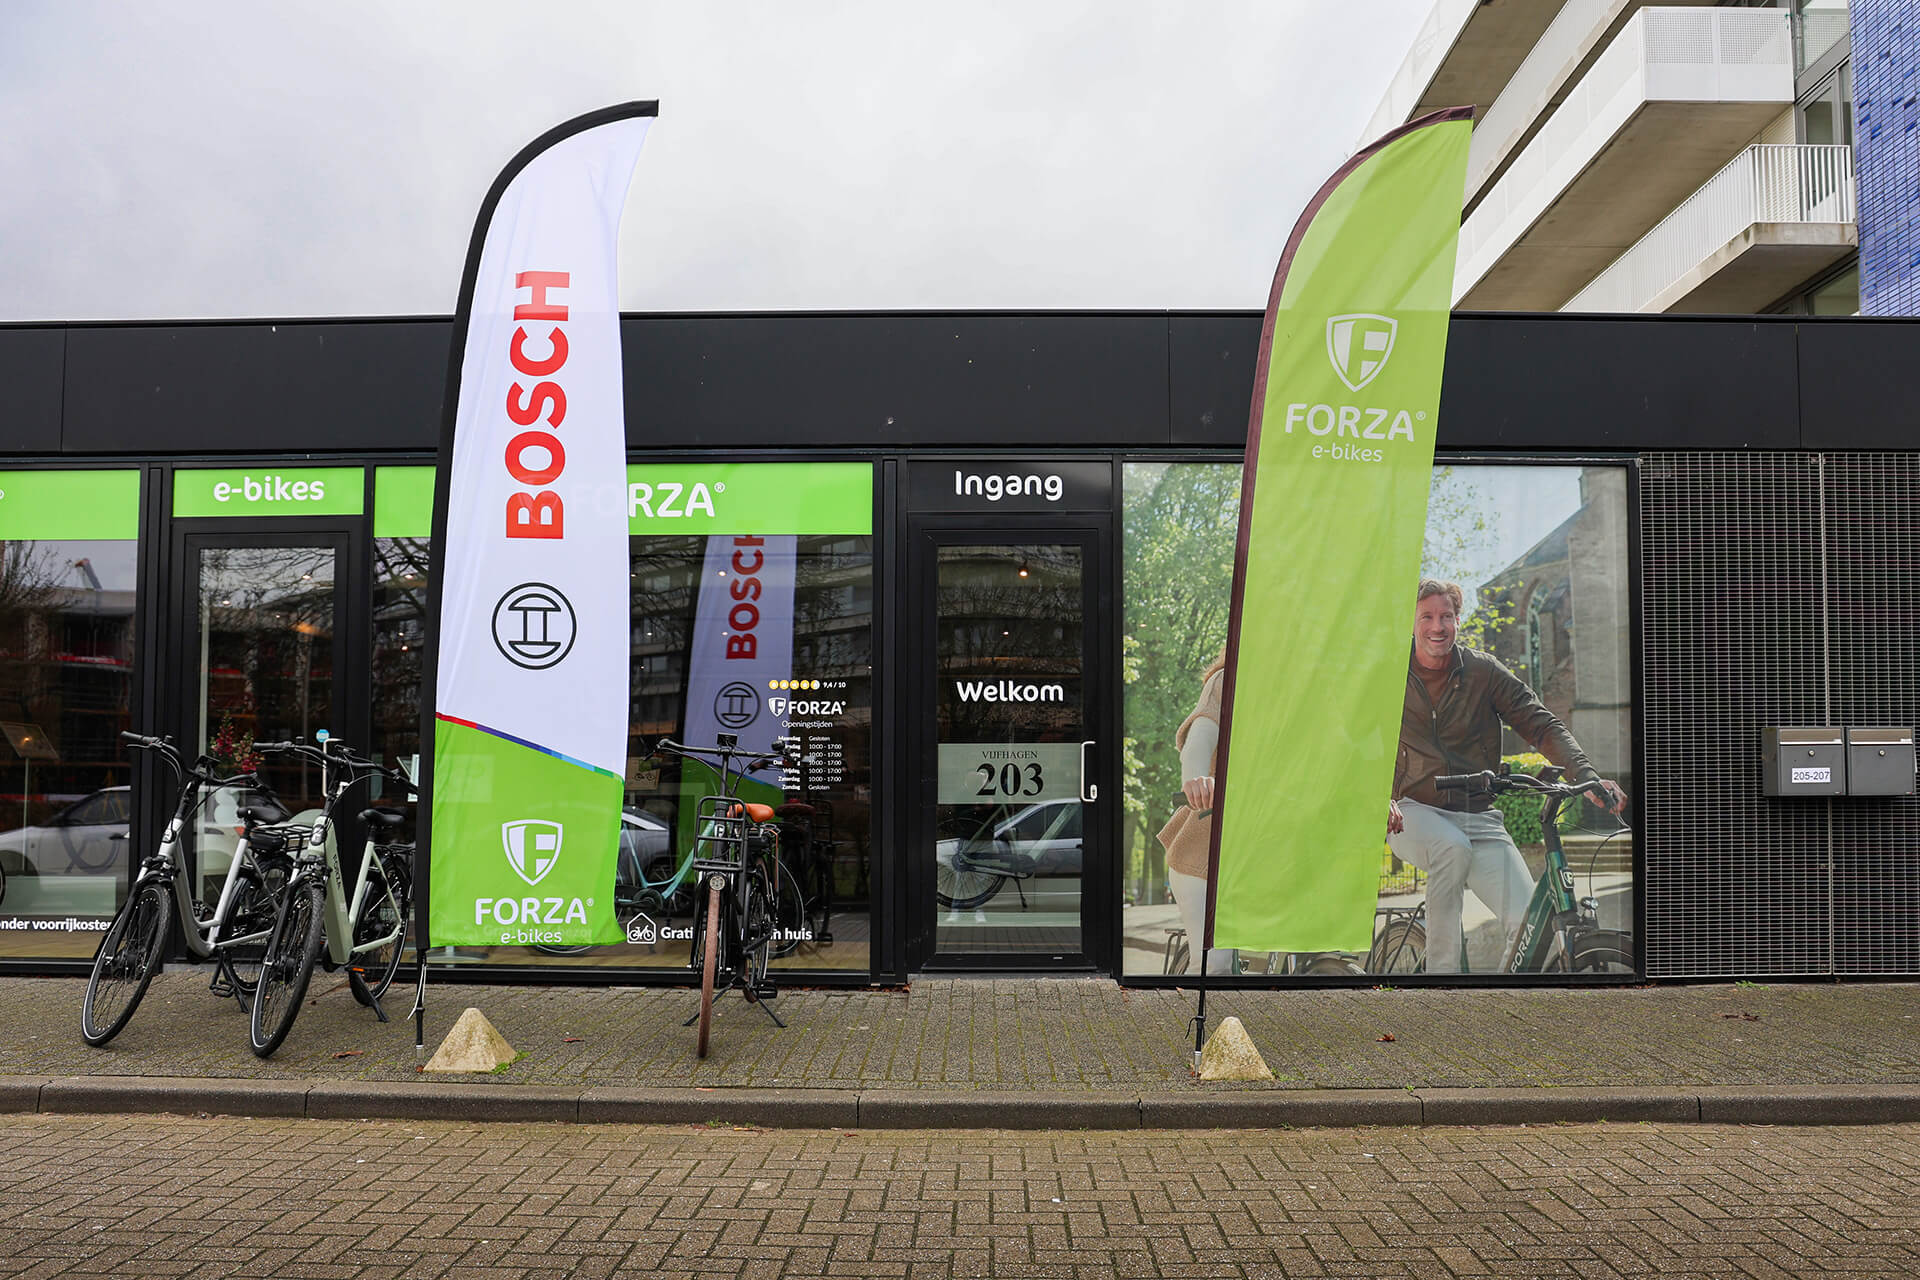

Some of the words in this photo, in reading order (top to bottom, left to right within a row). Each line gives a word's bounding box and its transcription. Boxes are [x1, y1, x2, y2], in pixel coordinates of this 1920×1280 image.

[505, 270, 570, 539] BOSCH
[1312, 442, 1383, 462] e-bikes
[213, 476, 325, 502] e-bikes
[955, 470, 1063, 501] Ingang
[956, 680, 1064, 702] Welkom
[781, 720, 833, 729] Openingstijden
[982, 751, 1038, 759] VIJFHAGEN
[976, 763, 1044, 796] 203
[1793, 771, 1830, 781] 205-207
[500, 929, 562, 944] e-bikes
[660, 926, 694, 939] Grati
[784, 927, 813, 940] huis
[1510, 923, 1535, 974] FORZA
